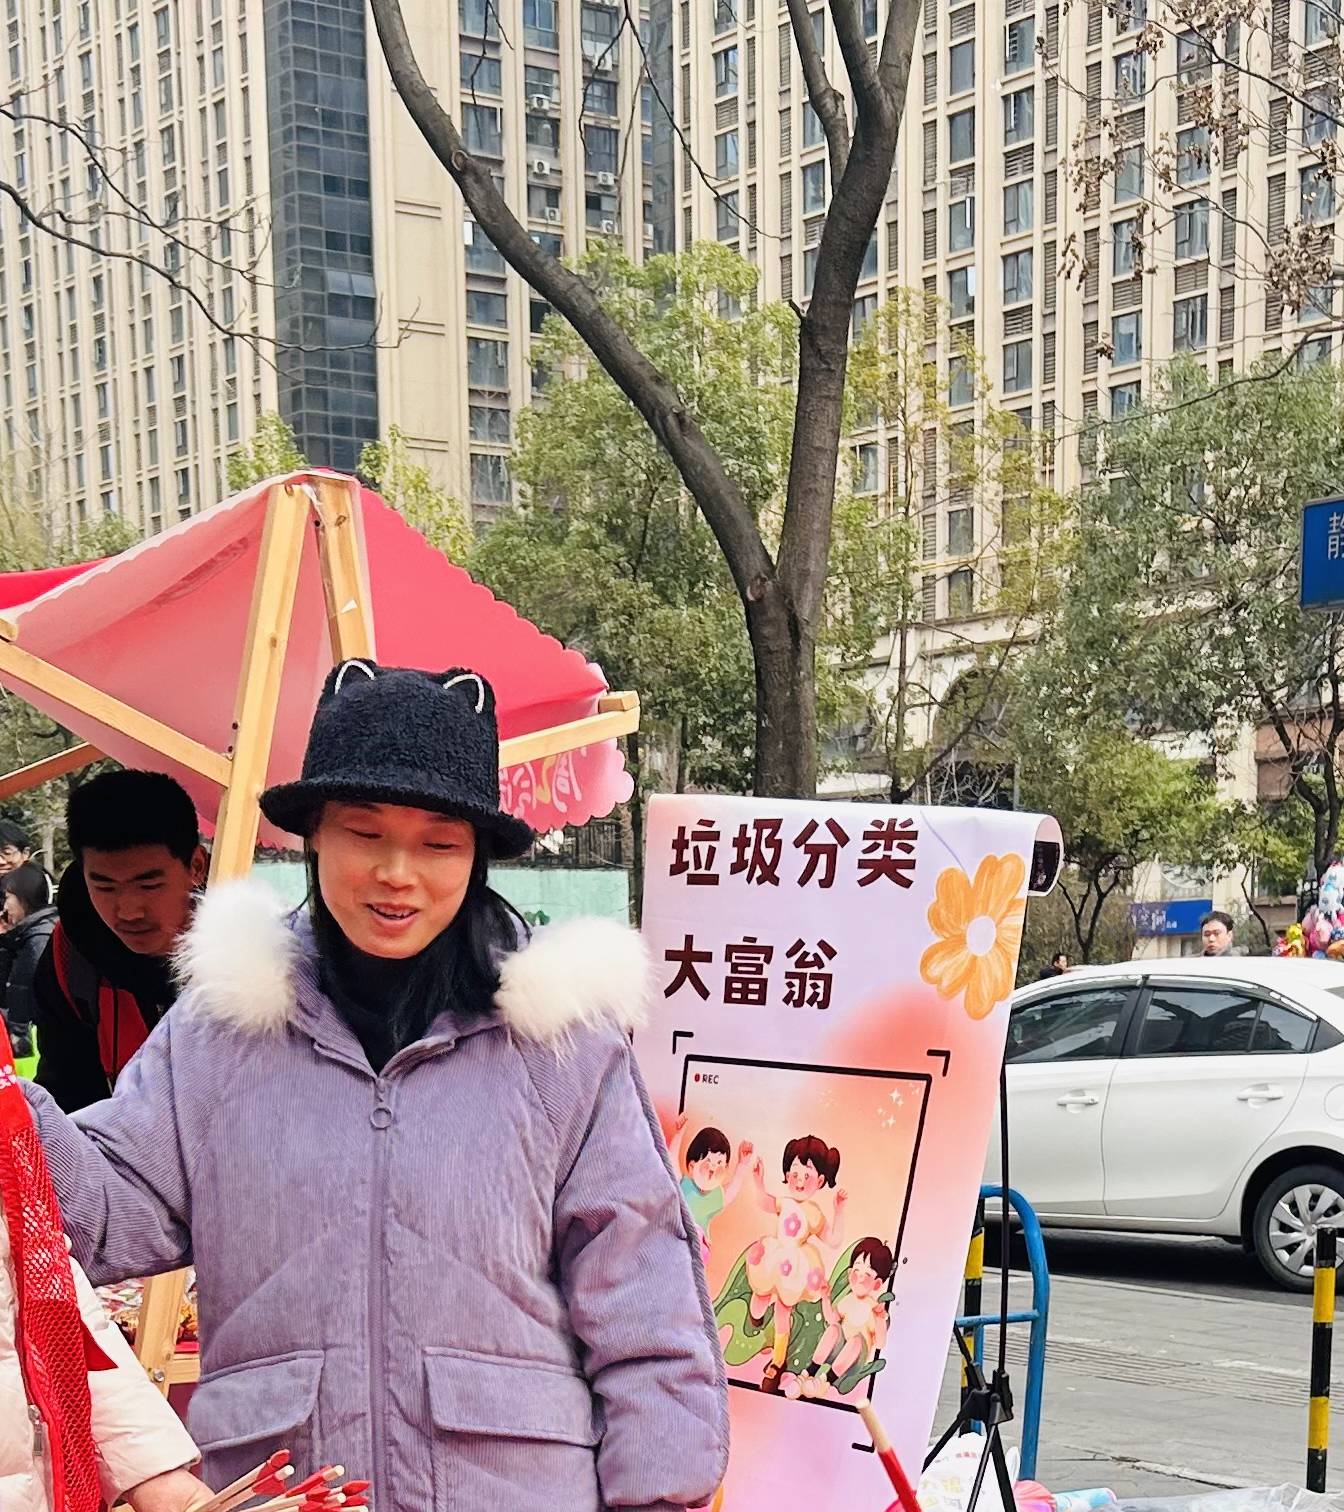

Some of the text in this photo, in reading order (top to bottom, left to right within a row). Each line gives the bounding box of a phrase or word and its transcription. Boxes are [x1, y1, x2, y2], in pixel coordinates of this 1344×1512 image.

[669, 817, 919, 889] 垃圾分类
[663, 934, 838, 1010] 大富翁
[701, 1072, 720, 1085] REC
